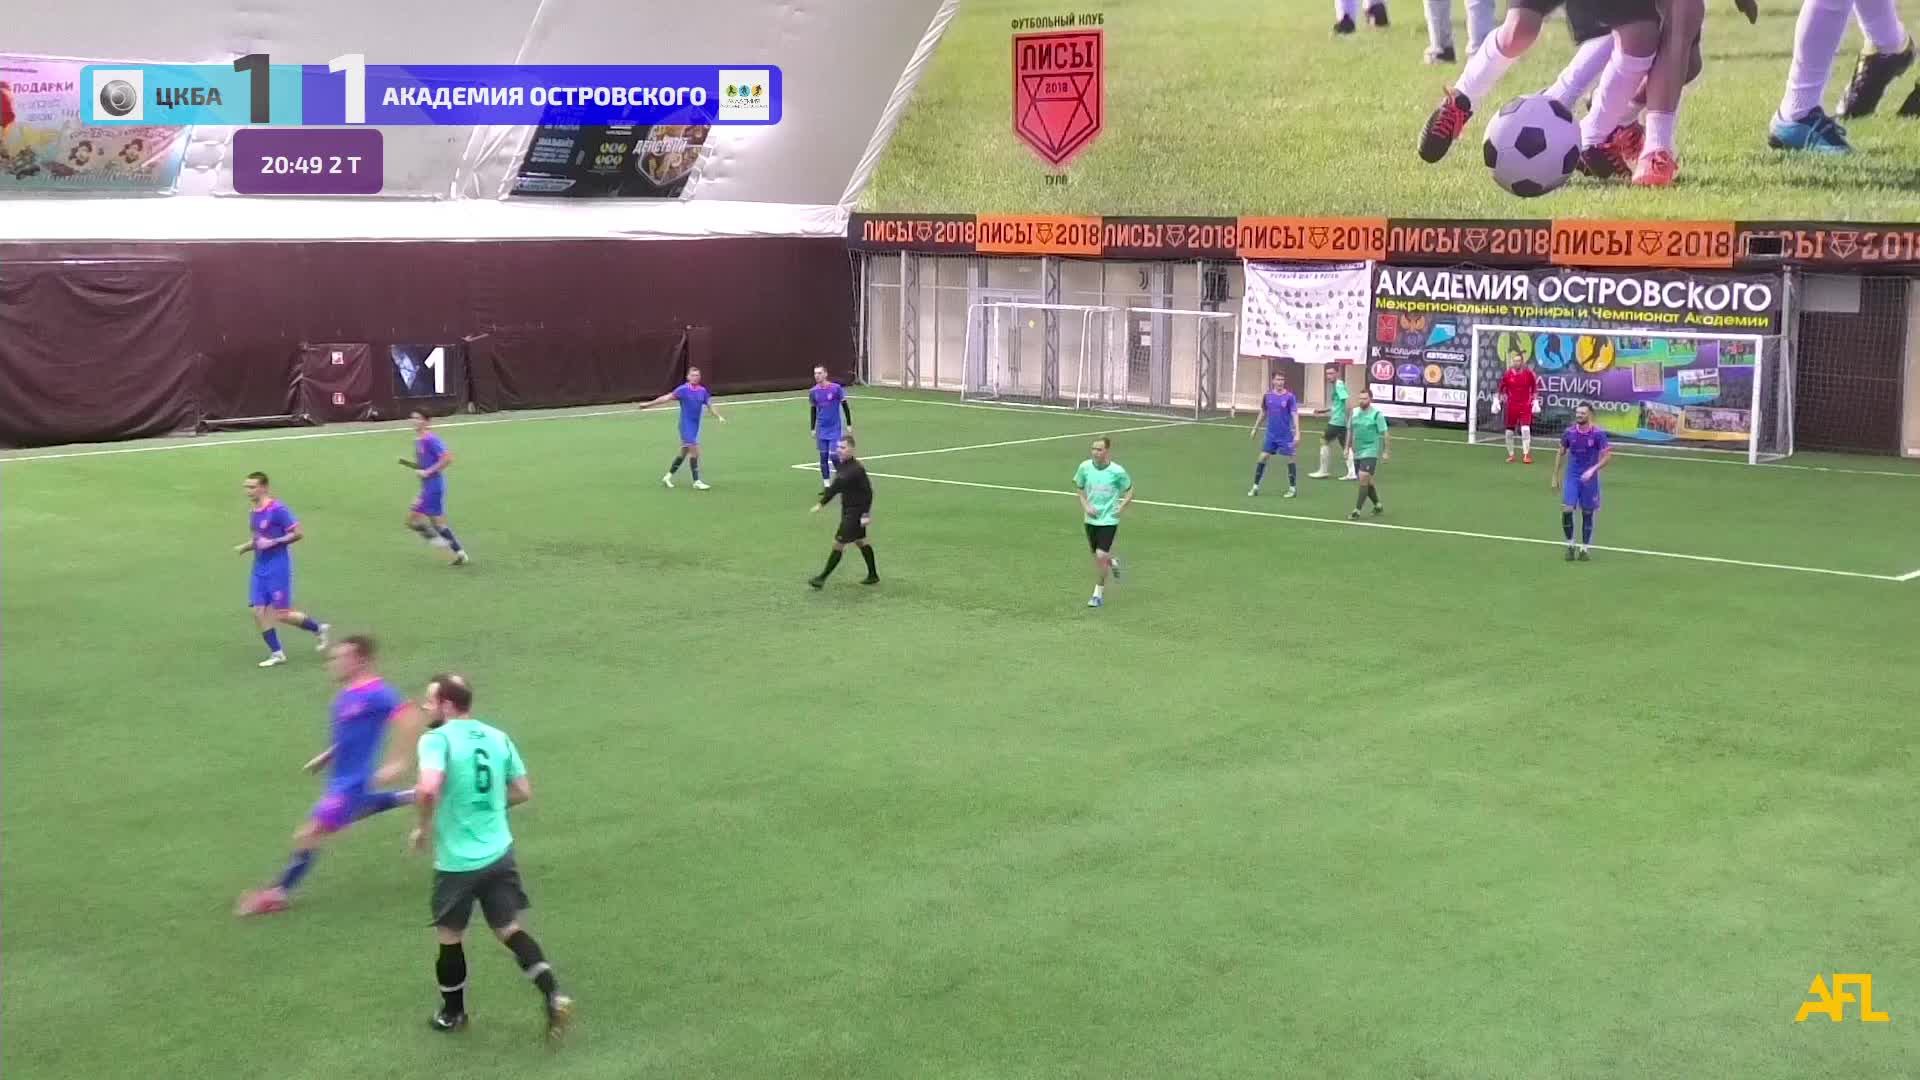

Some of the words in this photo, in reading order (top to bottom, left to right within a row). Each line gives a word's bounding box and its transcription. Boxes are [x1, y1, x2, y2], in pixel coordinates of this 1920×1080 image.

[1011, 13, 1075, 29] ФУТБОЛЬНЫЙ
[1079, 13, 1104, 25] КЛУБ
[1021, 41, 1094, 71] ЛИСЫ
[1045, 82, 1068, 94] 2018
[863, 220, 914, 242] ЛИСЫ
[934, 220, 976, 244] 2018
[978, 221, 1032, 244] ЛИСЫ
[1055, 223, 1100, 246] 2018
[1103, 224, 1163, 248] ЛИСЫ
[1187, 224, 1237, 249] 2018
[1239, 226, 1307, 249] ЛИСЫ
[1332, 226, 1385, 251] 2018
[1387, 227, 1461, 252] ЛИСЫ
[1489, 228, 1550, 254] 2018
[1553, 229, 1633, 257] ЛИСЫ
[1666, 231, 1730, 258] 2018
[1736, 230, 1825, 259] ЛСЫ
[1375, 270, 1529, 301] АКАДЕМИЯ
[1538, 274, 1772, 312] ОСТРОВСКОГО
[1375, 297, 1509, 315] Межрегиональные
[1513, 305, 1575, 318] турниры
[1577, 308, 1588, 318] и
[1591, 306, 1681, 324] Чемпионат
[1684, 311, 1769, 328] Академии
[424, 347, 445, 394] 1
[1547, 394, 1630, 412] Острского
[473, 748, 491, 793] 6
